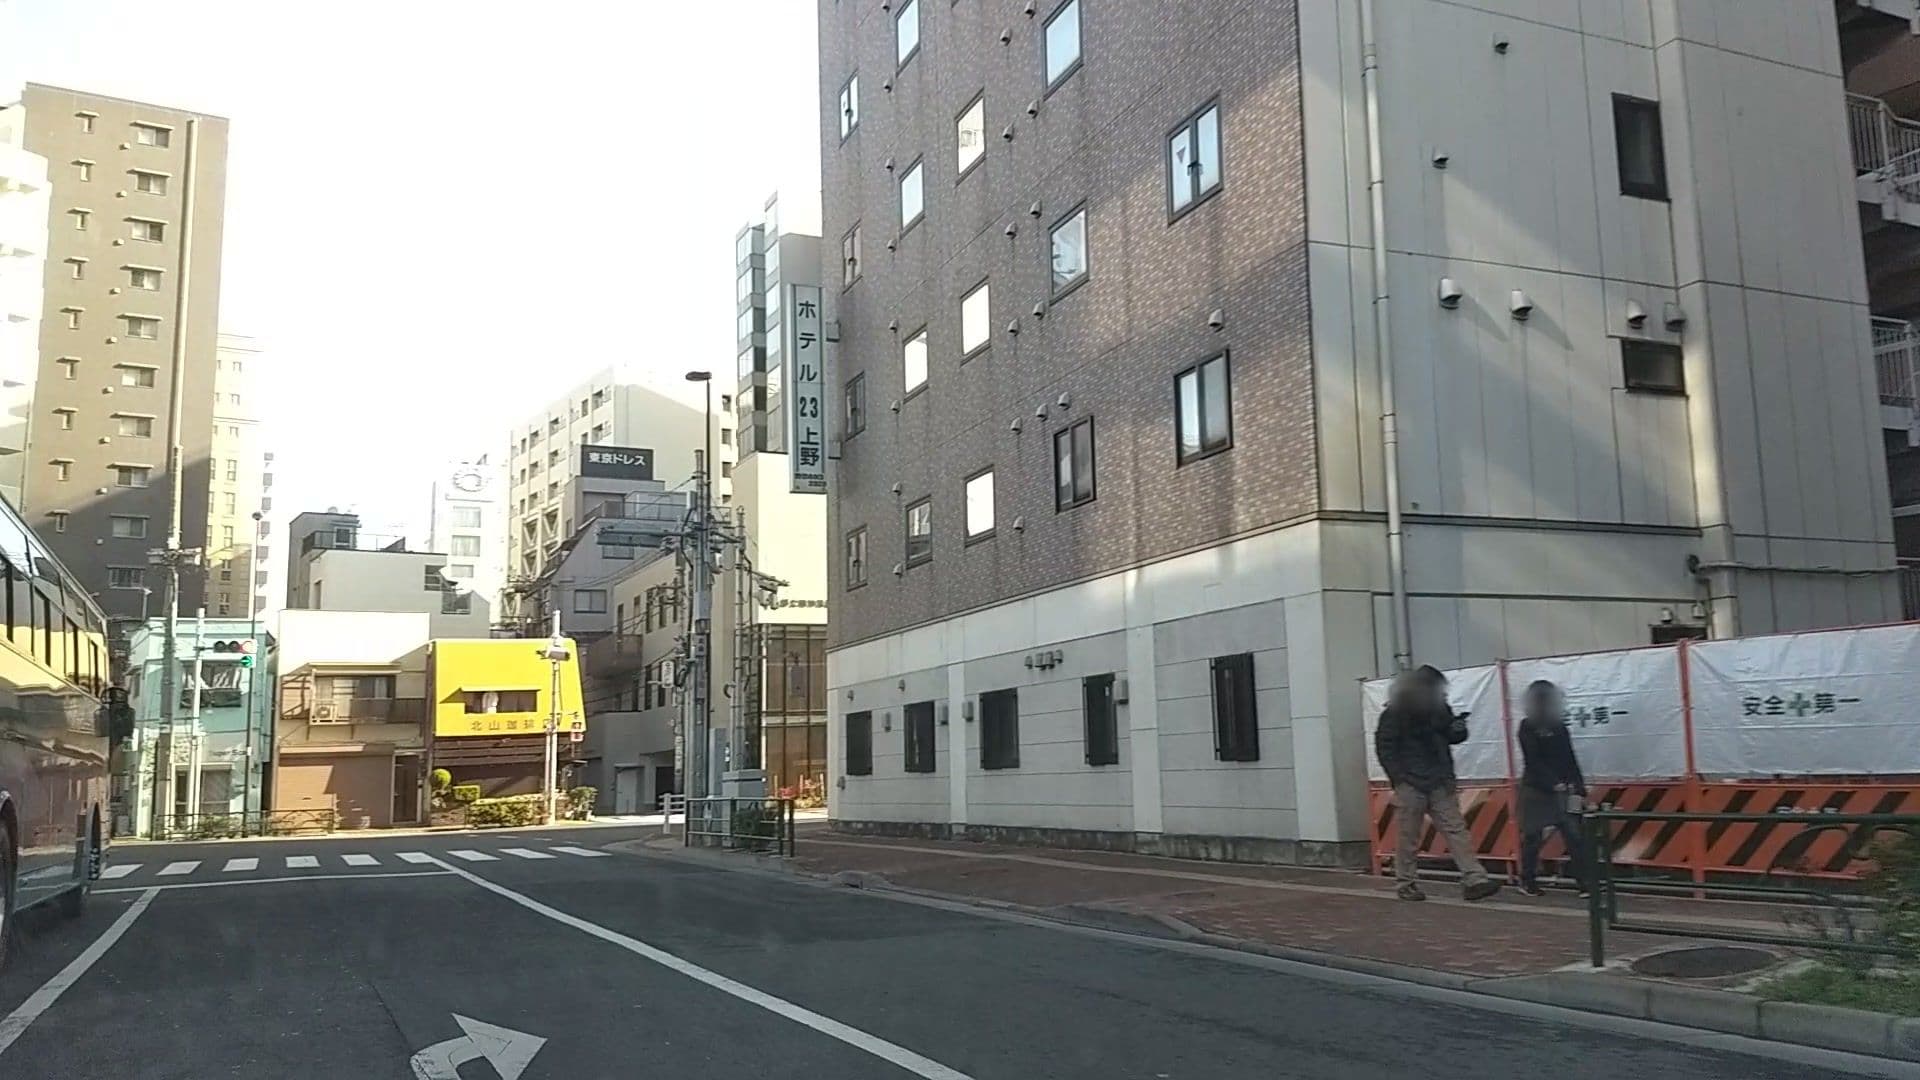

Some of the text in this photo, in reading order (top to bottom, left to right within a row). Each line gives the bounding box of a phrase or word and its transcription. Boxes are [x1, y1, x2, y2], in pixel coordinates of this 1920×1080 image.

[798, 300, 820, 467] ホテル23上野
[588, 452, 646, 466] 東京ドレス
[1742, 692, 1862, 716] 安全 第一
[1592, 706, 1629, 725] 第一
